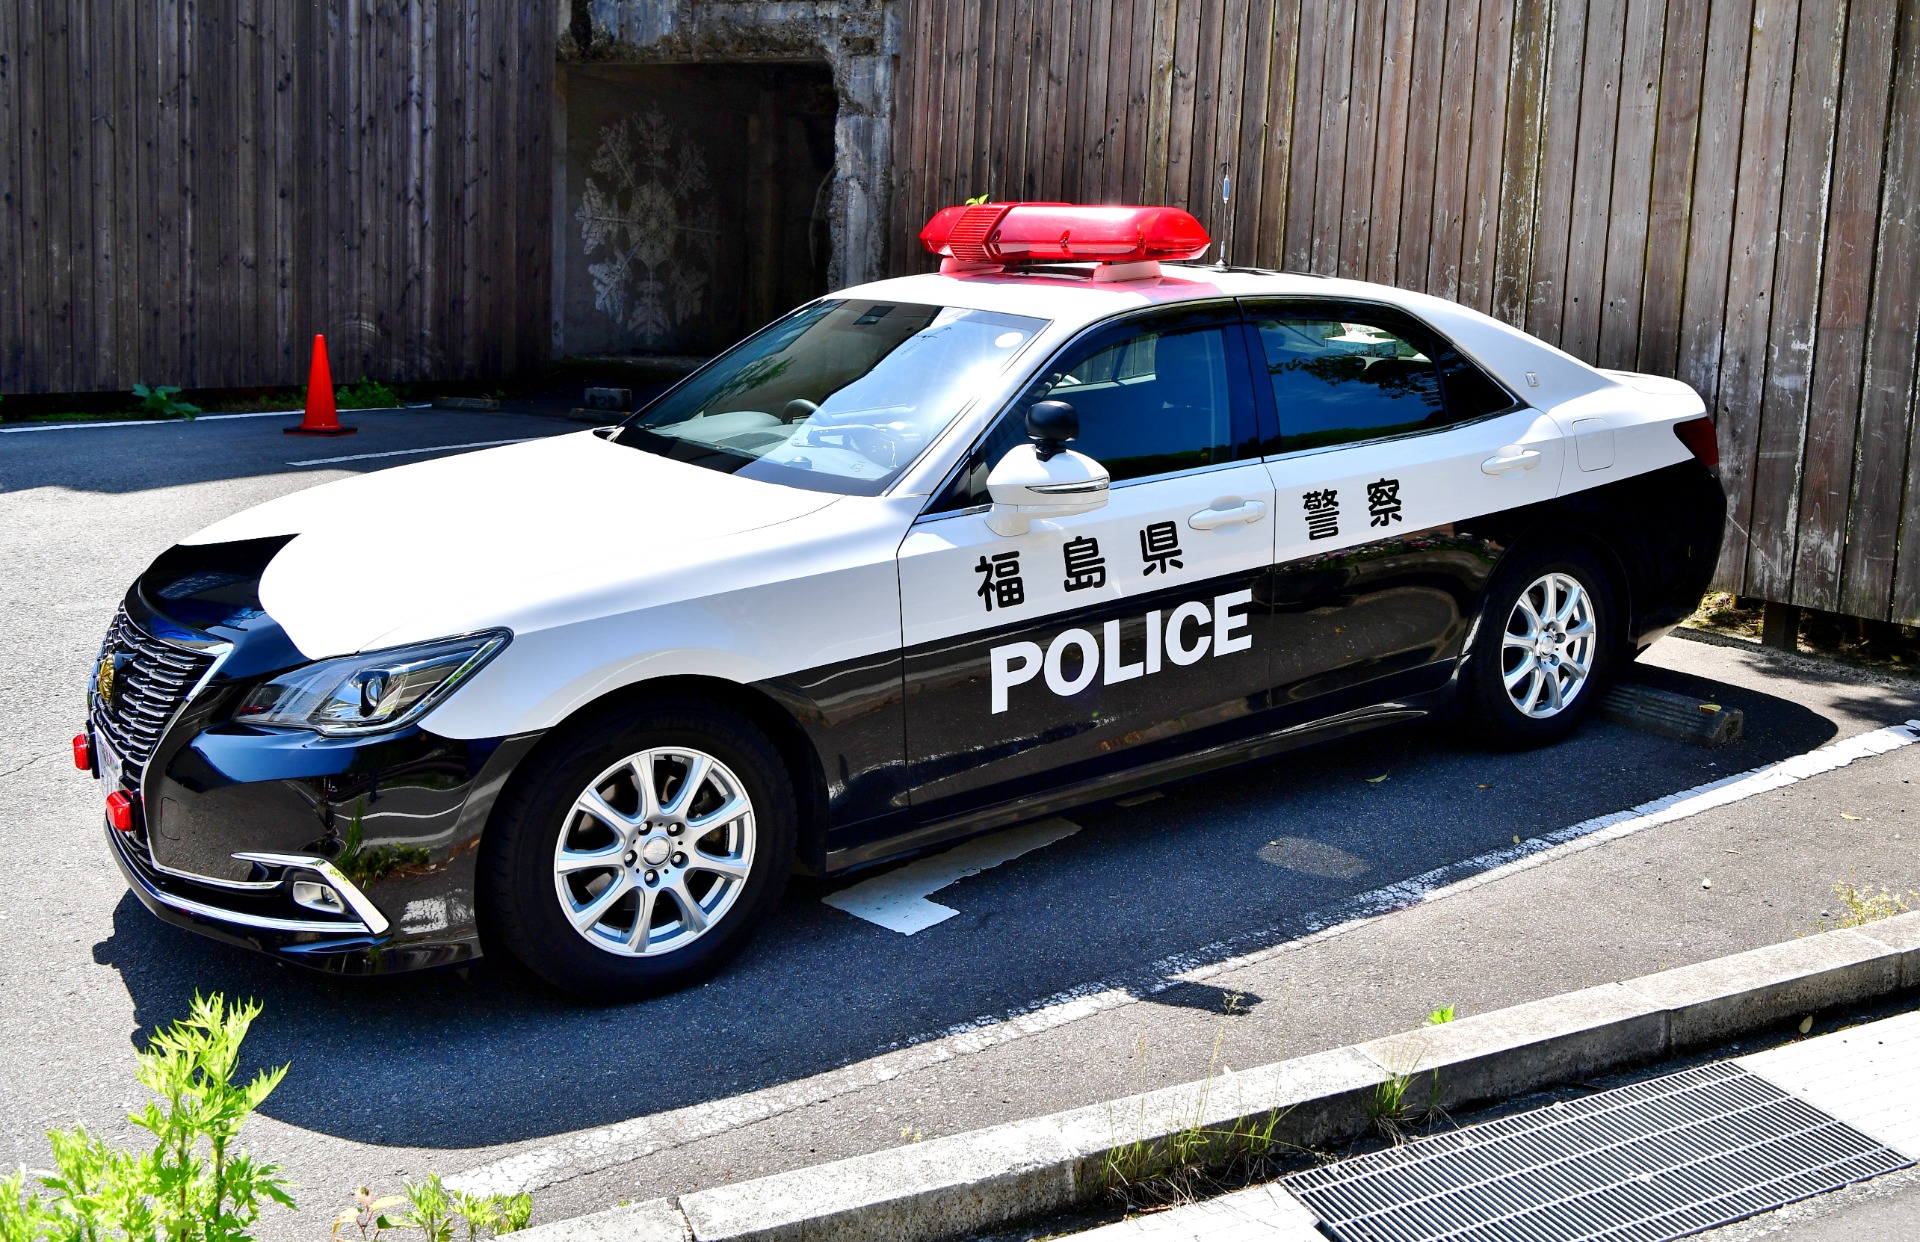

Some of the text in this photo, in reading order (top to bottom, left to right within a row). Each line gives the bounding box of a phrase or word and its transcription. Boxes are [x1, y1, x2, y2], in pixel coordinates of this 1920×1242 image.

[974, 477, 1403, 612] 福島県 警察
[990, 588, 1253, 715] POLICE
